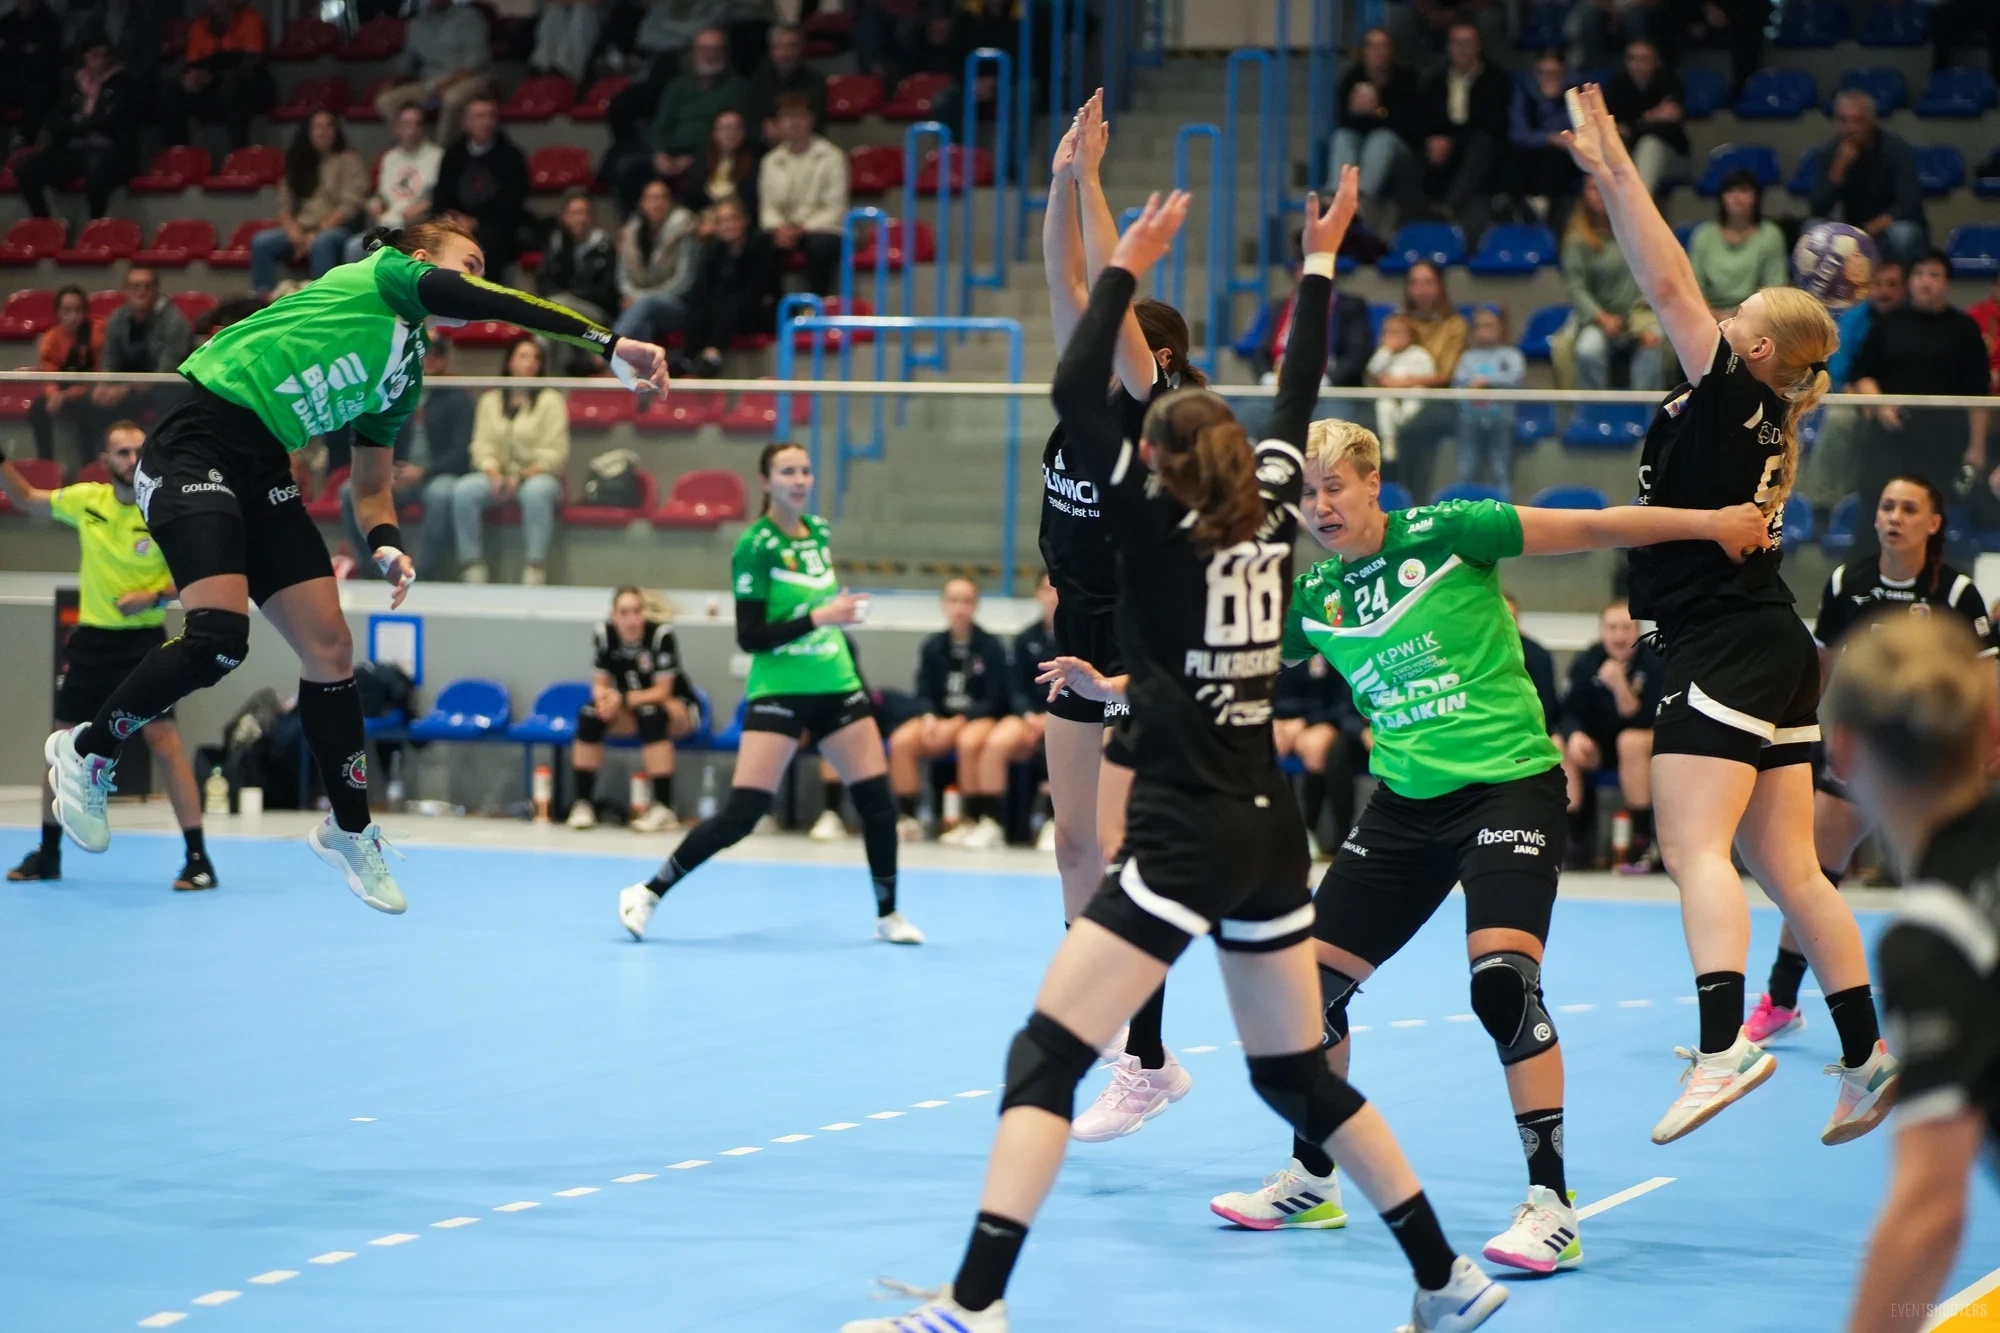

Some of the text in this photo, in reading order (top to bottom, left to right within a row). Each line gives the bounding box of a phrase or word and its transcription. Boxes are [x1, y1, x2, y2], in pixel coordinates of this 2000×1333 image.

[1088, 508, 1100, 518] tu
[1358, 556, 1388, 579] ORLEN
[1354, 576, 1389, 626] 24
[1376, 630, 1439, 667] KPWiK
[1476, 828, 1546, 847] fbserwis
[1513, 844, 1540, 856] JAKO
